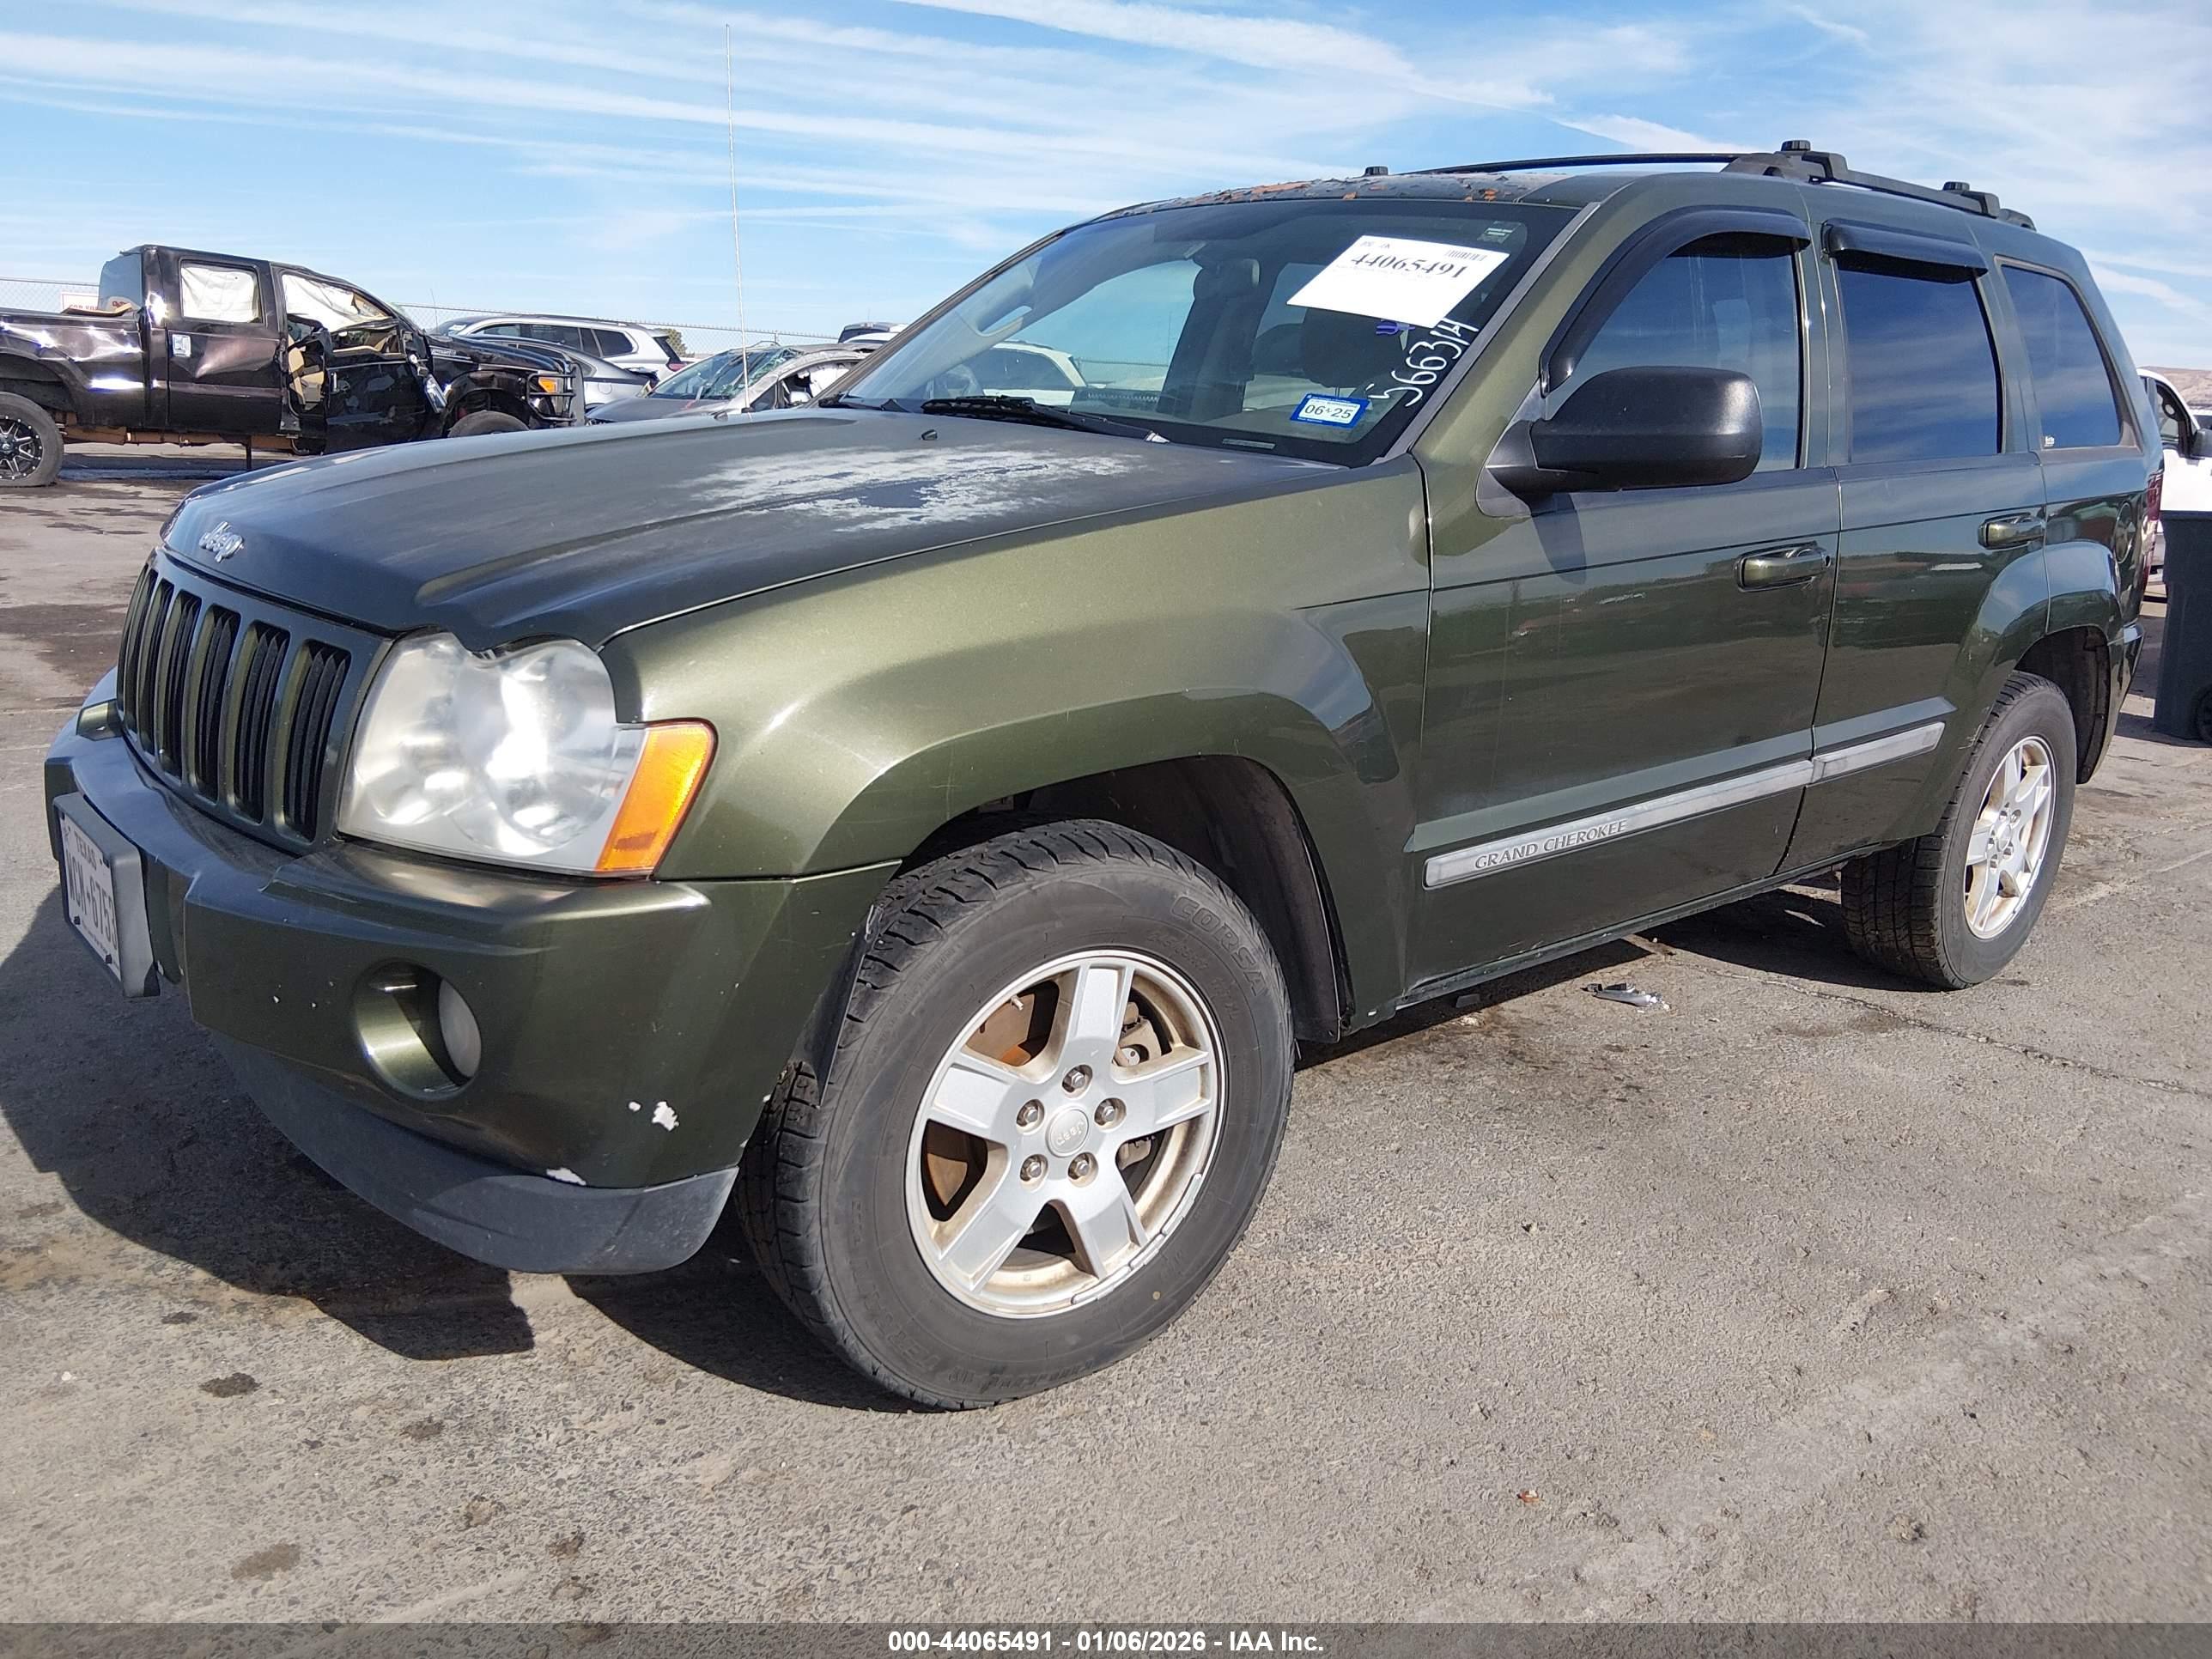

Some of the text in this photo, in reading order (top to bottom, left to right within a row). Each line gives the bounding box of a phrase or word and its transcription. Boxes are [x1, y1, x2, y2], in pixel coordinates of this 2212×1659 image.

[1351, 252, 1469, 279] 44065491
[1304, 404, 1327, 416] 06
[1330, 407, 1355, 420] 25
[74, 830, 97, 872] TEXAS
[1474, 818, 1629, 870] GRAND CHEROKEE
[1170, 895, 1269, 997] CORSA
